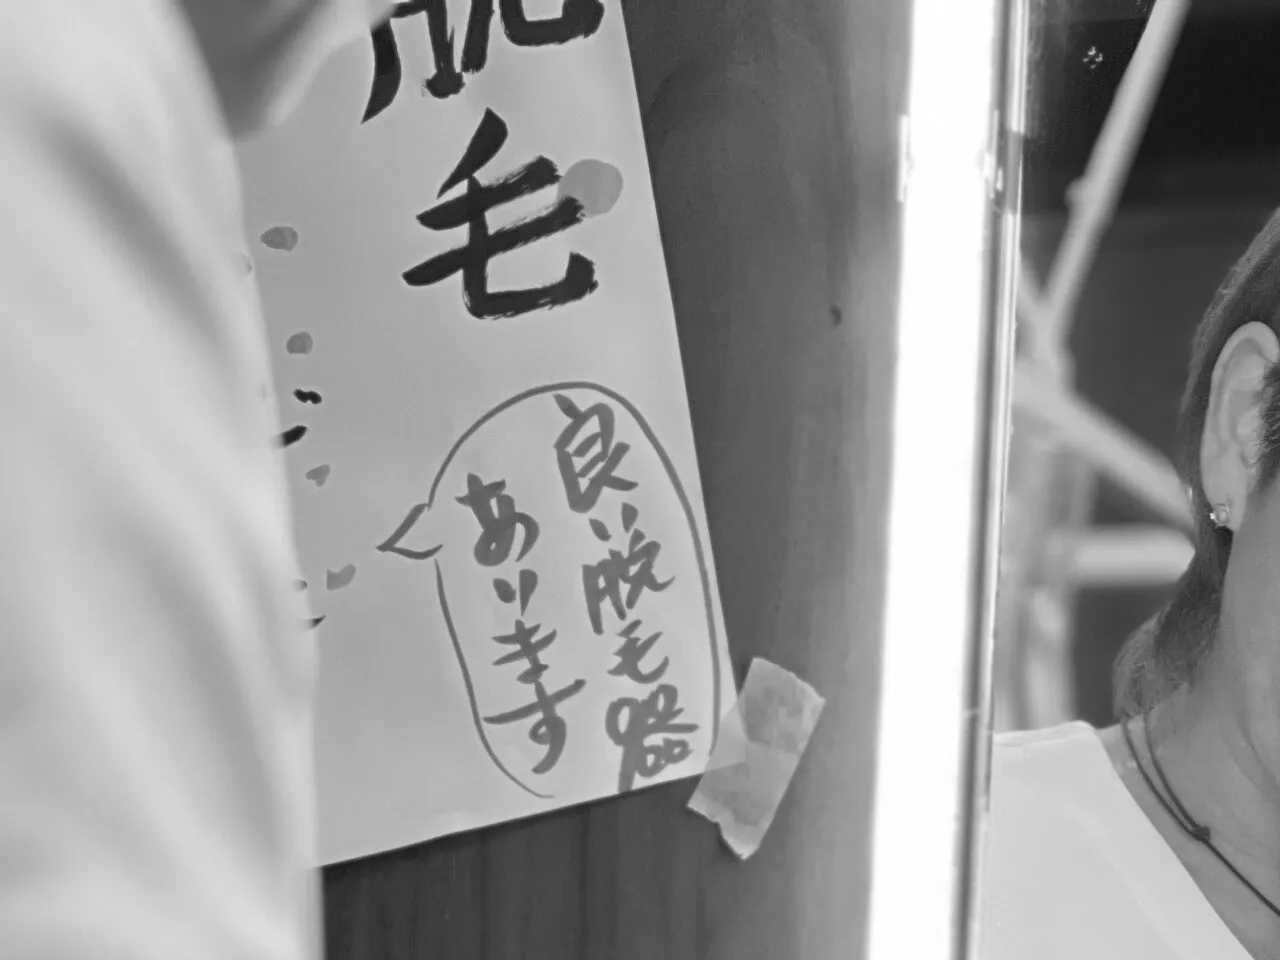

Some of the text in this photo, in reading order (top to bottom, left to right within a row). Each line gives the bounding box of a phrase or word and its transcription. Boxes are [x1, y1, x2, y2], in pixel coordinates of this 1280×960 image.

[455, 472, 587, 775] あります
[552, 393, 700, 793] 良い脱毛器
